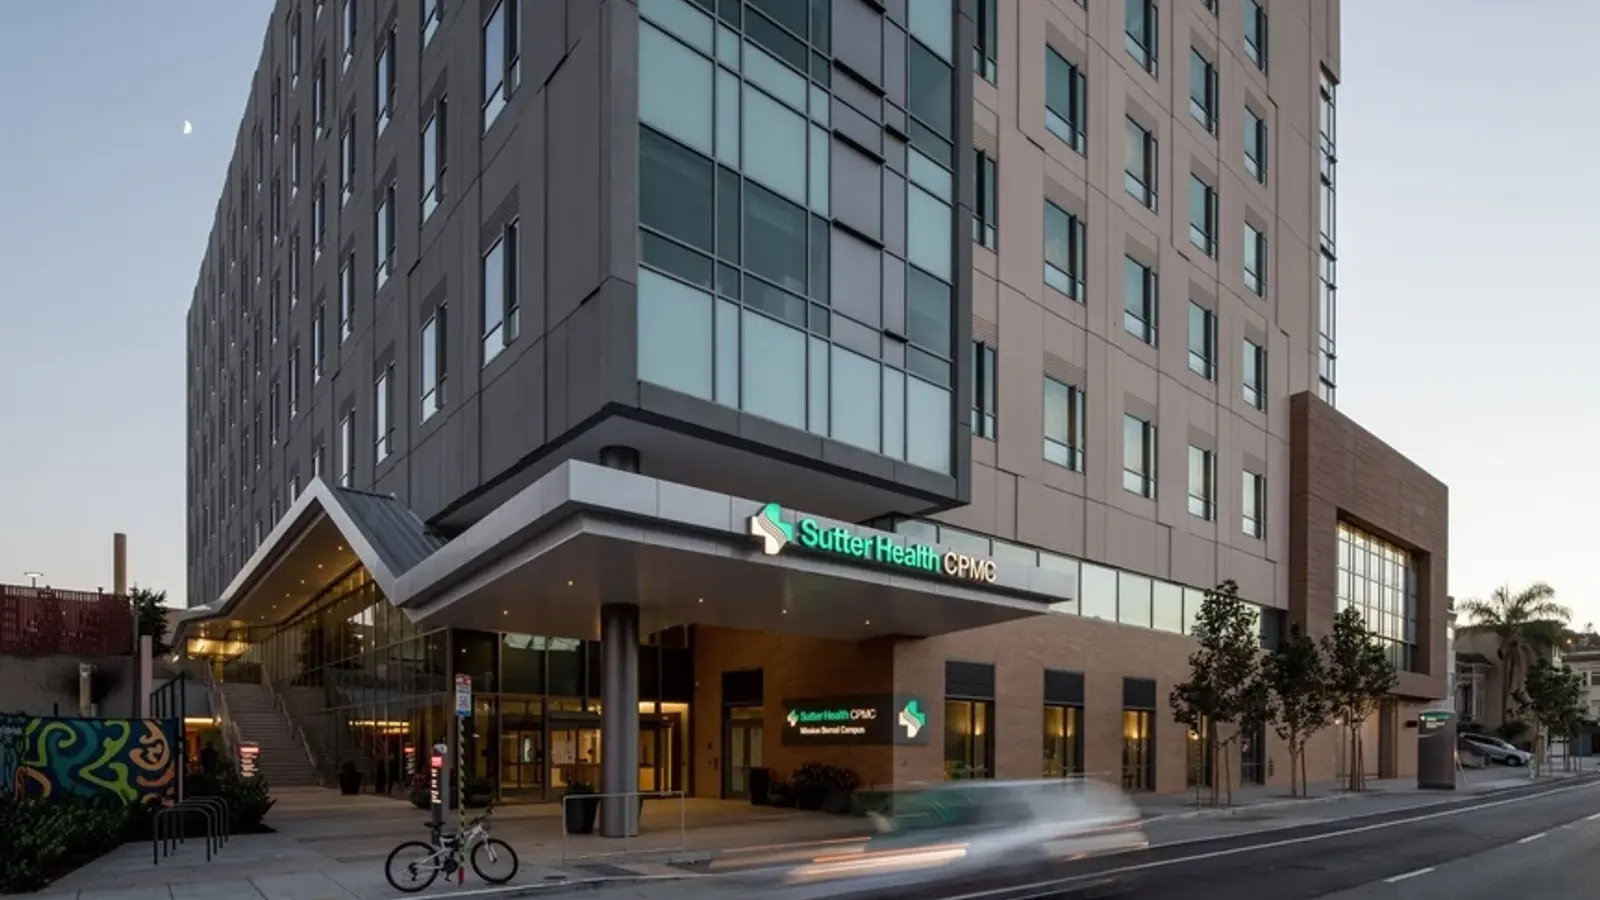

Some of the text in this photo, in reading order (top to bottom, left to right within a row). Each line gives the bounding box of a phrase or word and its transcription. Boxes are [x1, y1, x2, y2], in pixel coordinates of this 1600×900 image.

[800, 518, 997, 583] Sutter Health CPMC
[800, 708, 877, 721] Sutter Health CPMC
